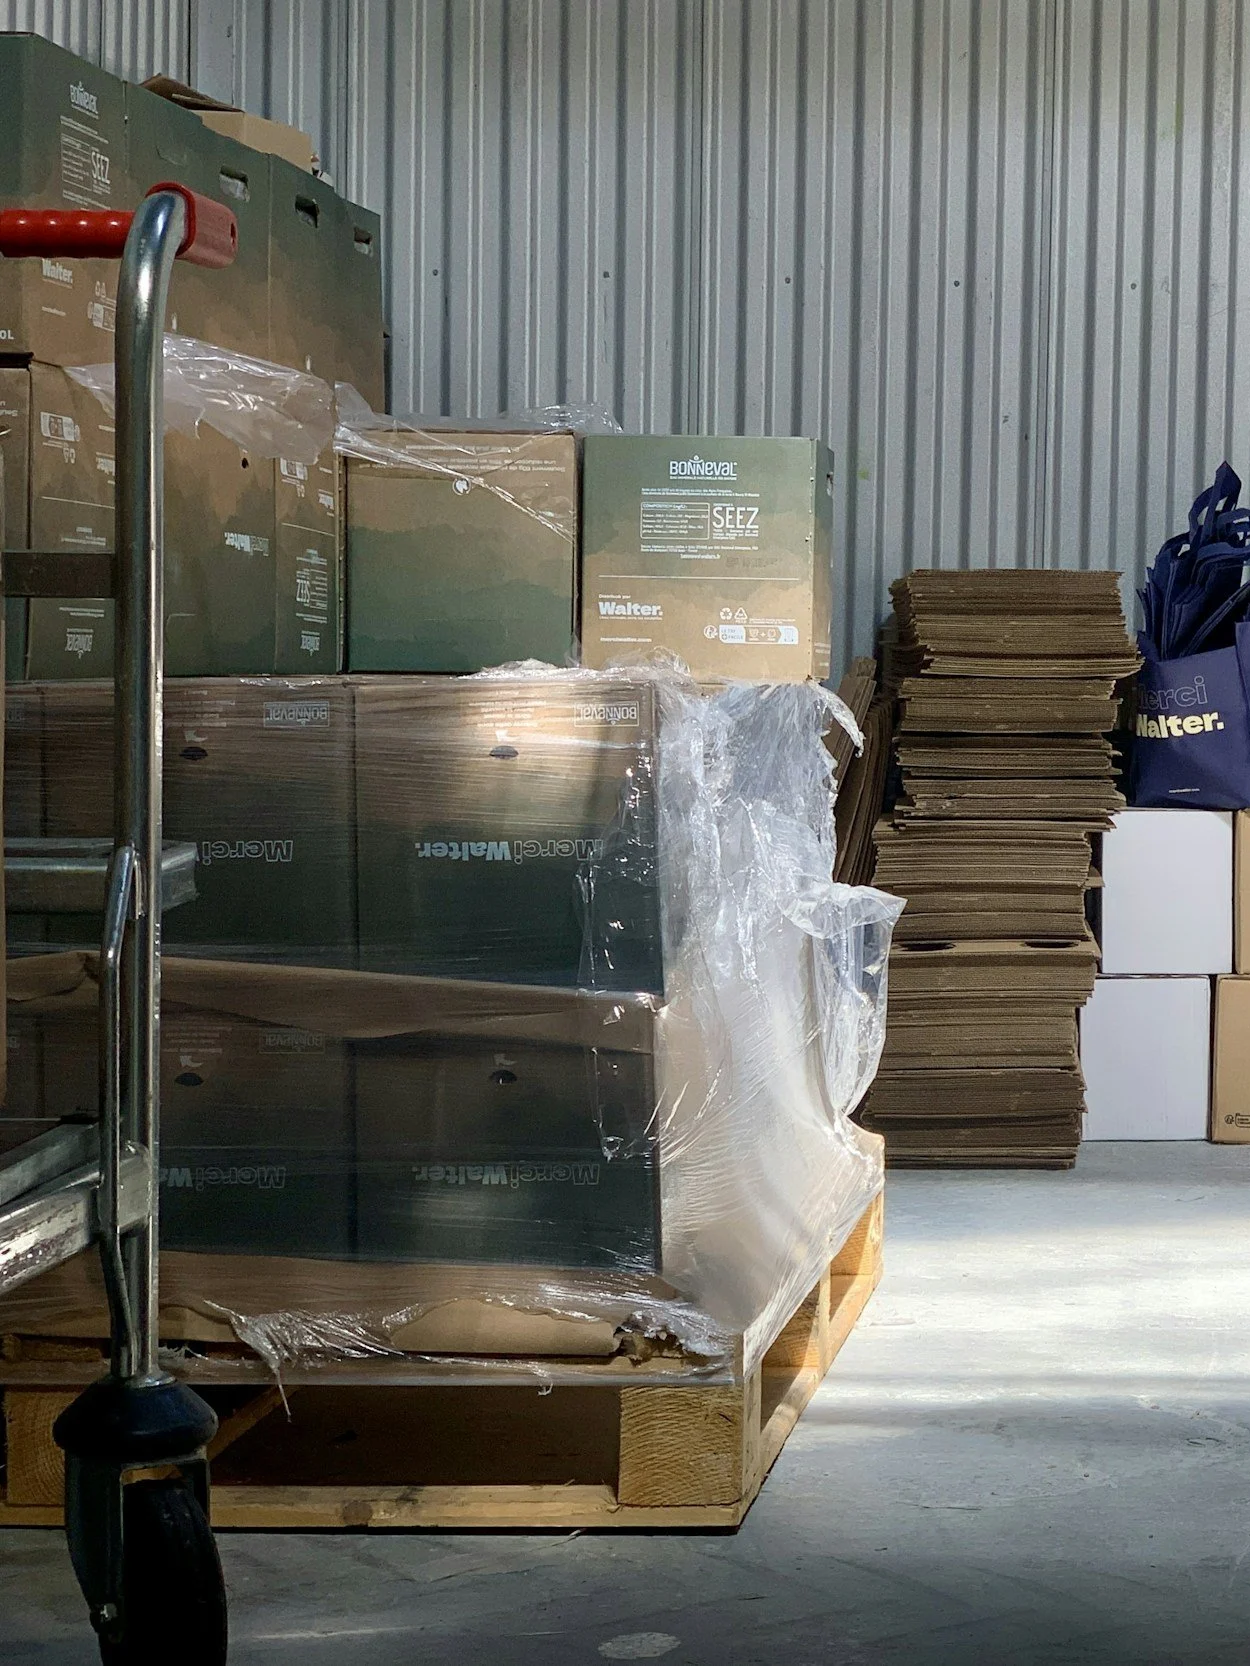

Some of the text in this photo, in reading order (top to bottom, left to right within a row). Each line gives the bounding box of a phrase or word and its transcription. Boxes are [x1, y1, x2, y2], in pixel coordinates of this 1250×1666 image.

[92, 151, 110, 184] SEEZ
[713, 507, 759, 529] SEEZ
[598, 601, 663, 616] Walter.
[201, 840, 293, 865] Merci
[414, 839, 604, 865] Merci Walter.
[195, 1167, 286, 1191] Merci
[412, 1163, 600, 1189] Merci Walter.
